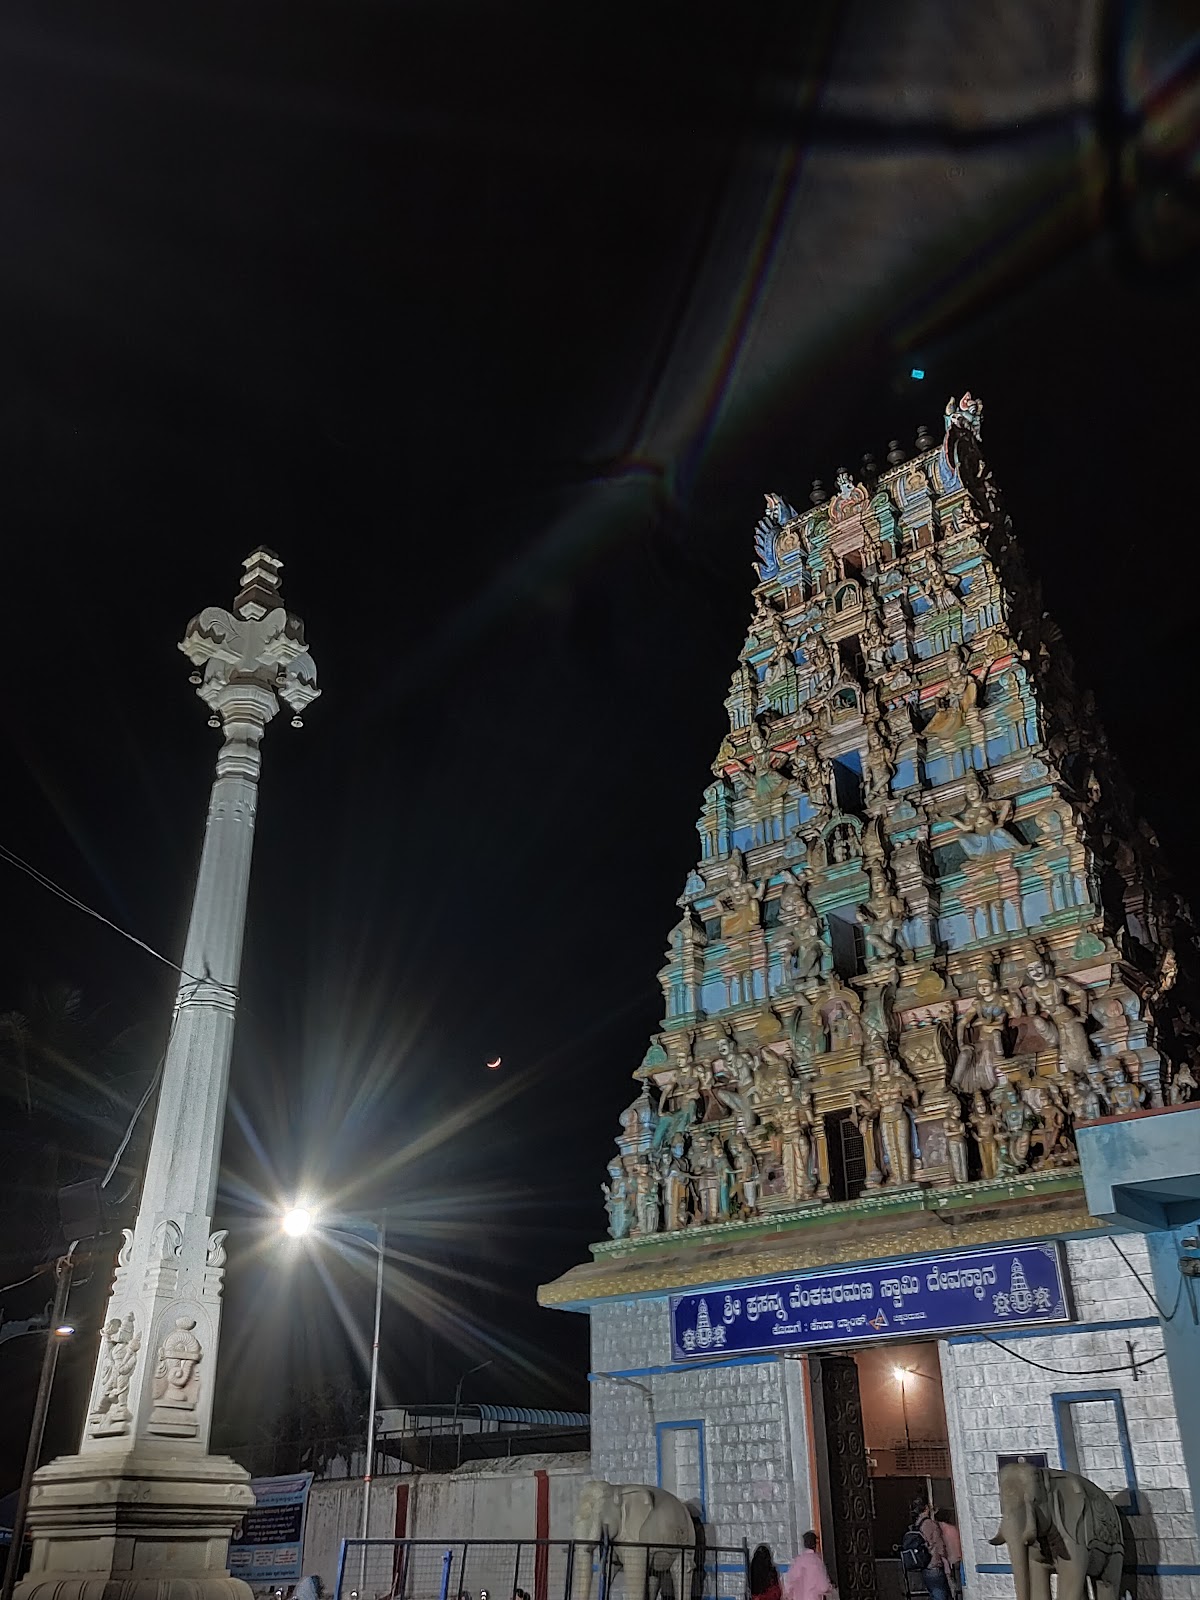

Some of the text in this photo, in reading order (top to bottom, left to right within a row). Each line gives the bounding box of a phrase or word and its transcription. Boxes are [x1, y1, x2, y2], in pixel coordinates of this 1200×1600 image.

[723, 1264, 998, 1324] ಶ್ರೀ ಪ್ರಸನ್ನ ವೆಂಕಟರಮಣ ಸ್ವಾಮಿ ದೇವಸ್ಥಾನ
